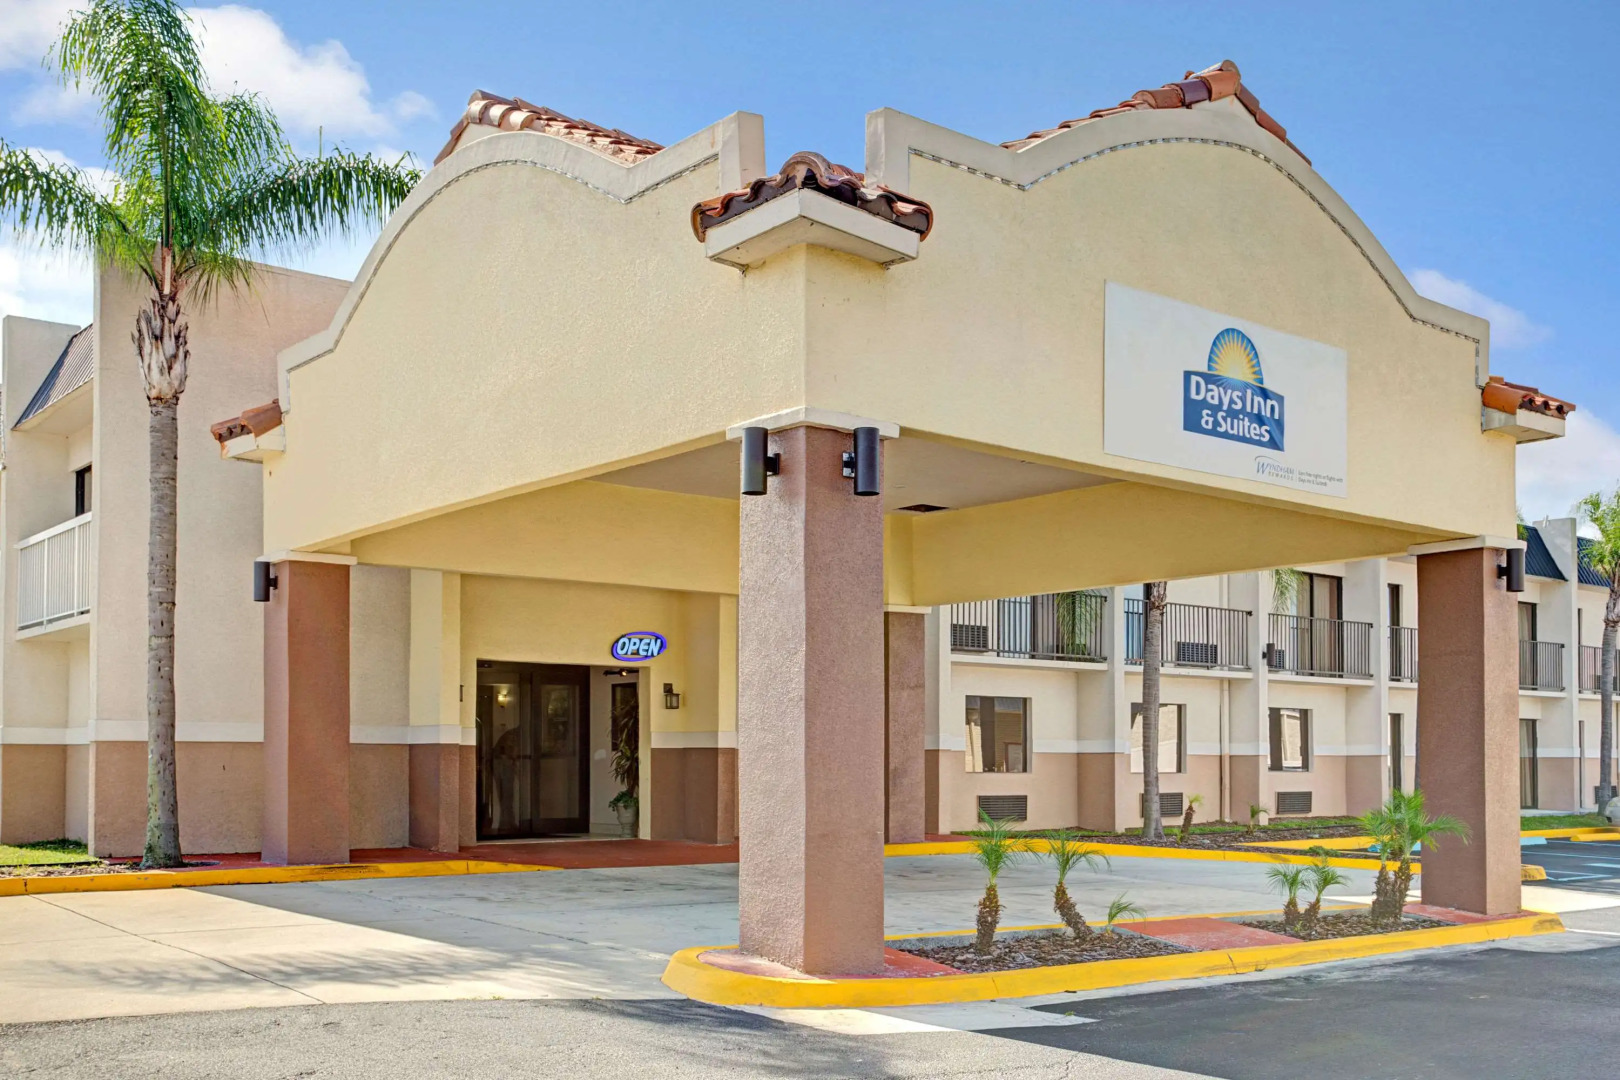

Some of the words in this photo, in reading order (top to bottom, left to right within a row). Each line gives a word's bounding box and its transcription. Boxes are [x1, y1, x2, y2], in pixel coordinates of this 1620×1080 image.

[1190, 375, 1243, 410] Days
[1246, 389, 1279, 420] Inn
[1201, 409, 1214, 430] &
[1217, 411, 1270, 442] Suites
[616, 637, 661, 657] OPEN
